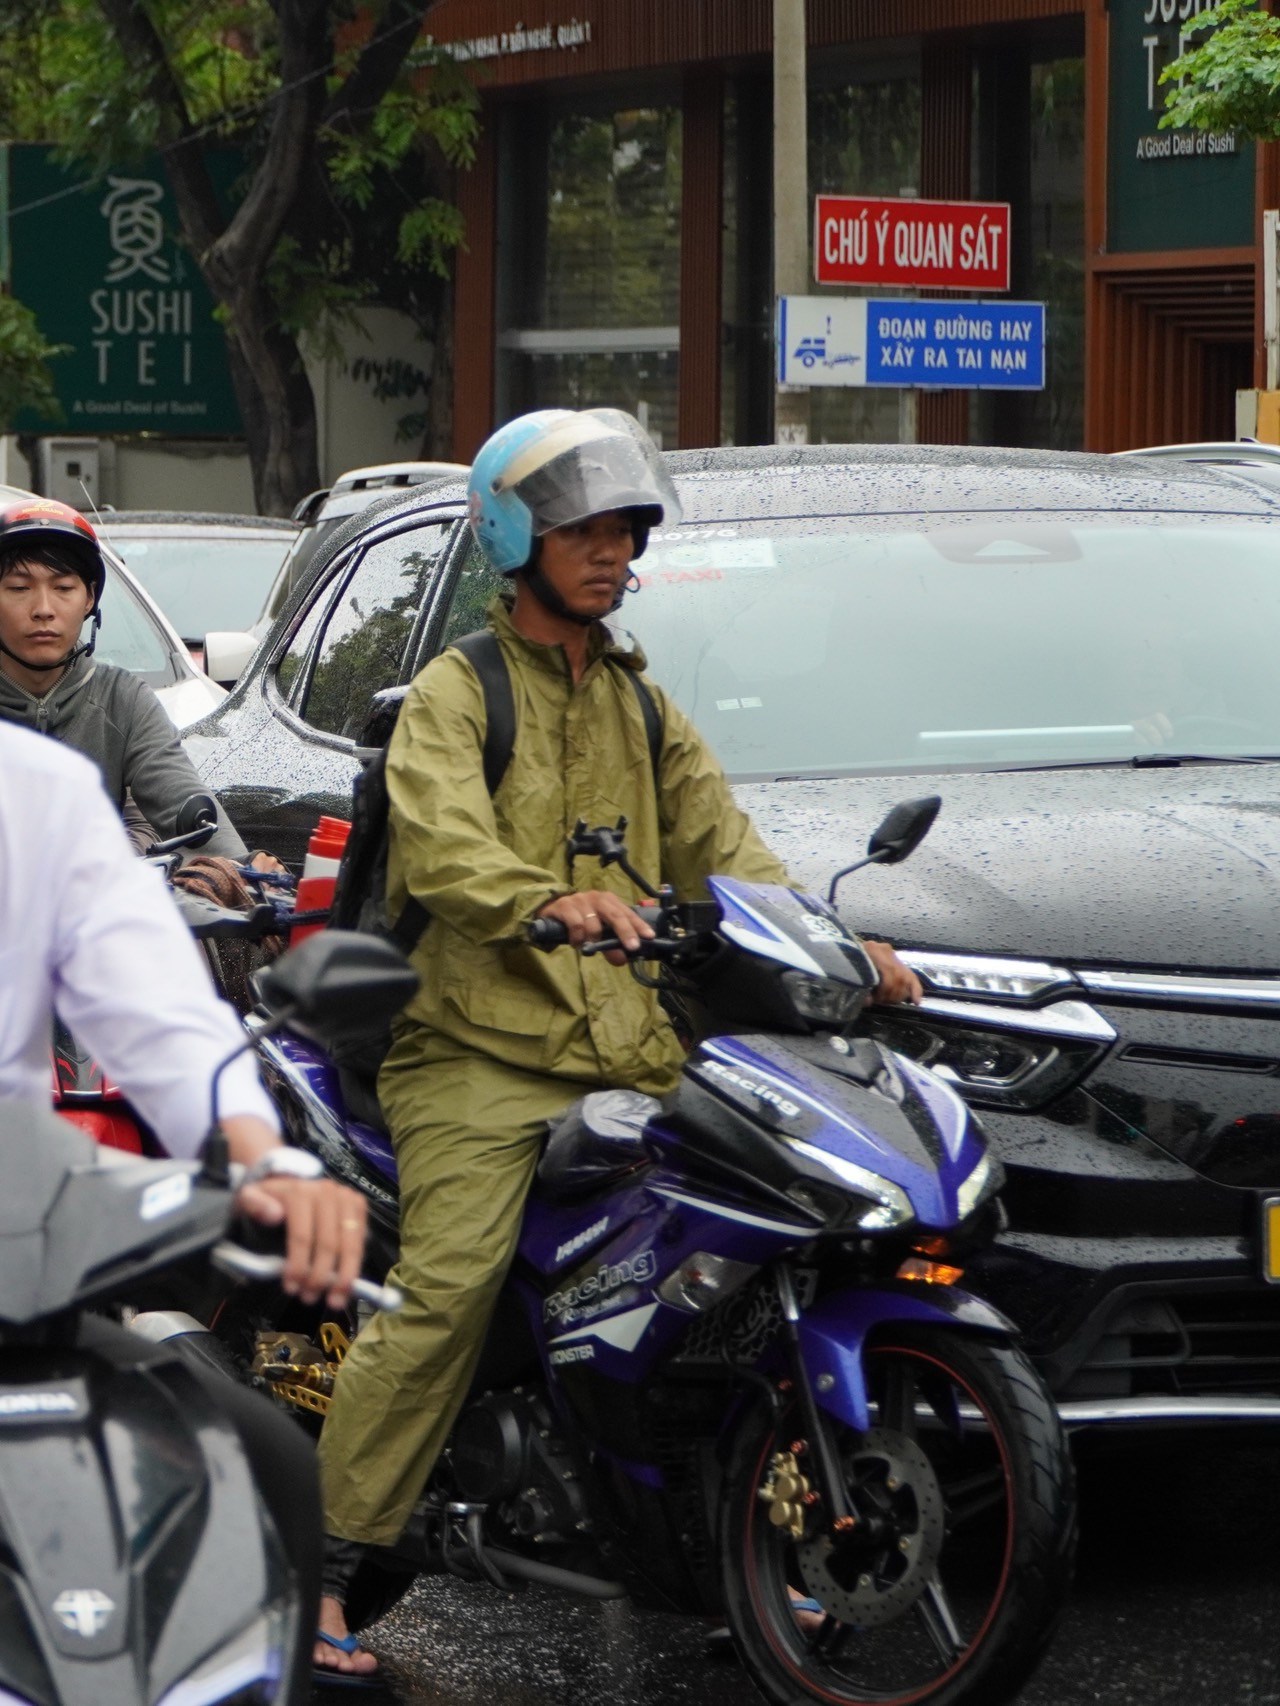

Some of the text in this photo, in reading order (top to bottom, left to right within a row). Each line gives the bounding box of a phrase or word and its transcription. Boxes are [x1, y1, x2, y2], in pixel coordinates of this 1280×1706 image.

[1136, 131, 1235, 159] A Good Deal of Sushi
[824, 208, 1002, 270] CHÚ Ý QUAN SÁT
[90, 288, 192, 335] SUSHI
[878, 313, 1032, 342] ĐOẠN ĐƯỜNG HAY
[92, 340, 192, 386] TEI
[924, 348, 948, 368] RA
[956, 348, 981, 369] TAI
[991, 350, 1026, 375] NẠN
[73, 399, 207, 415] A Good Deal of Sushi
[660, 569, 723, 584] TAXI
[701, 1060, 801, 1117] Racing
